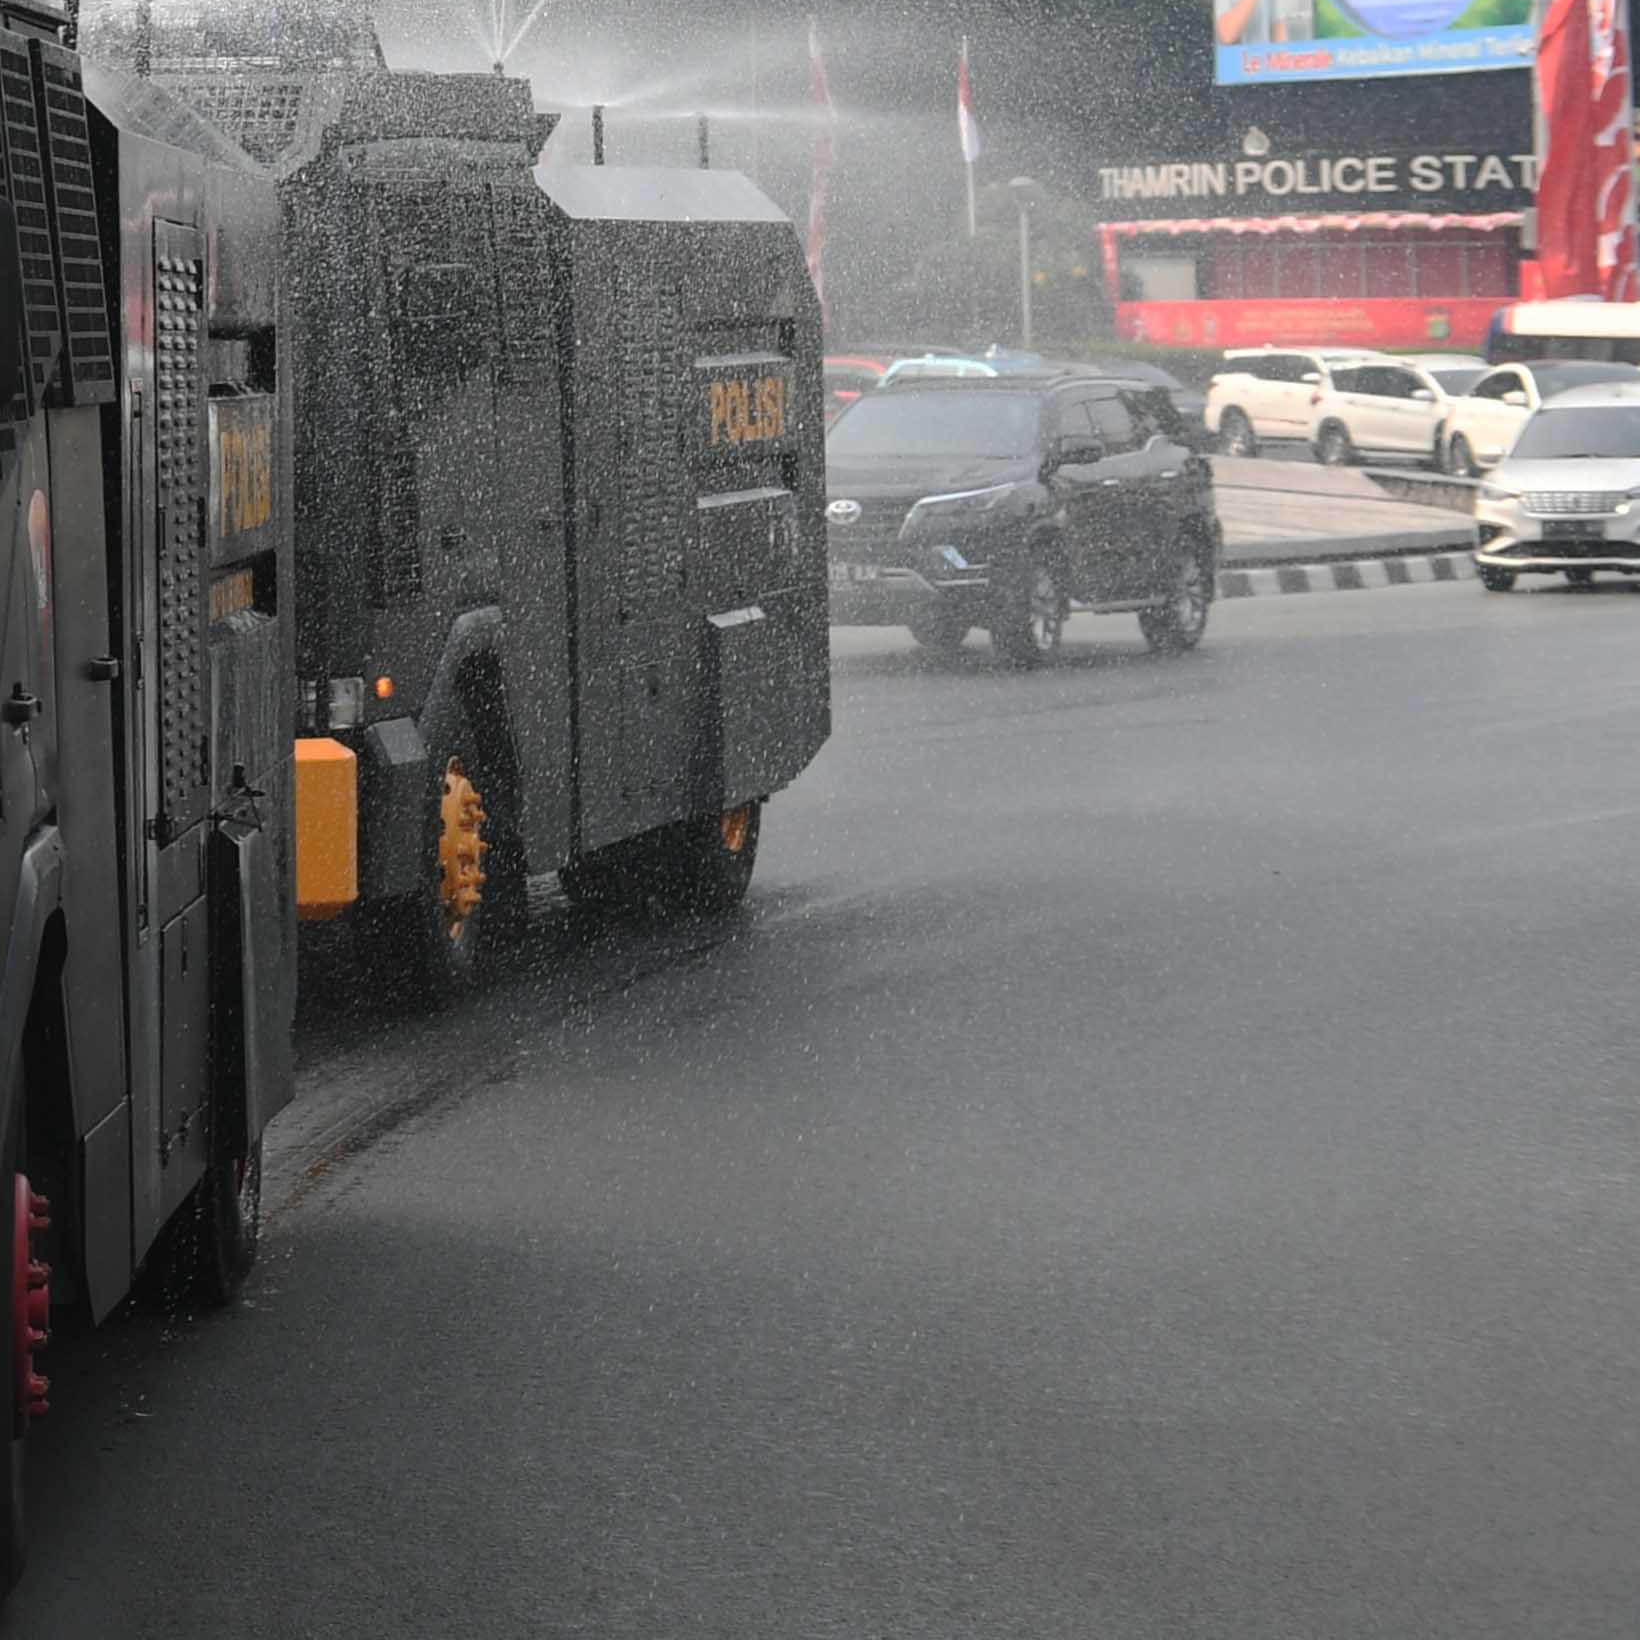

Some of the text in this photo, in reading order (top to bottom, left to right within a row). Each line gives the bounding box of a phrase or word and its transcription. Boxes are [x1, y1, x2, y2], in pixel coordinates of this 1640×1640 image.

[1099, 162, 1225, 200] THAMRIN
[1234, 157, 1400, 196] POLICE
[710, 376, 784, 447] POLISI
